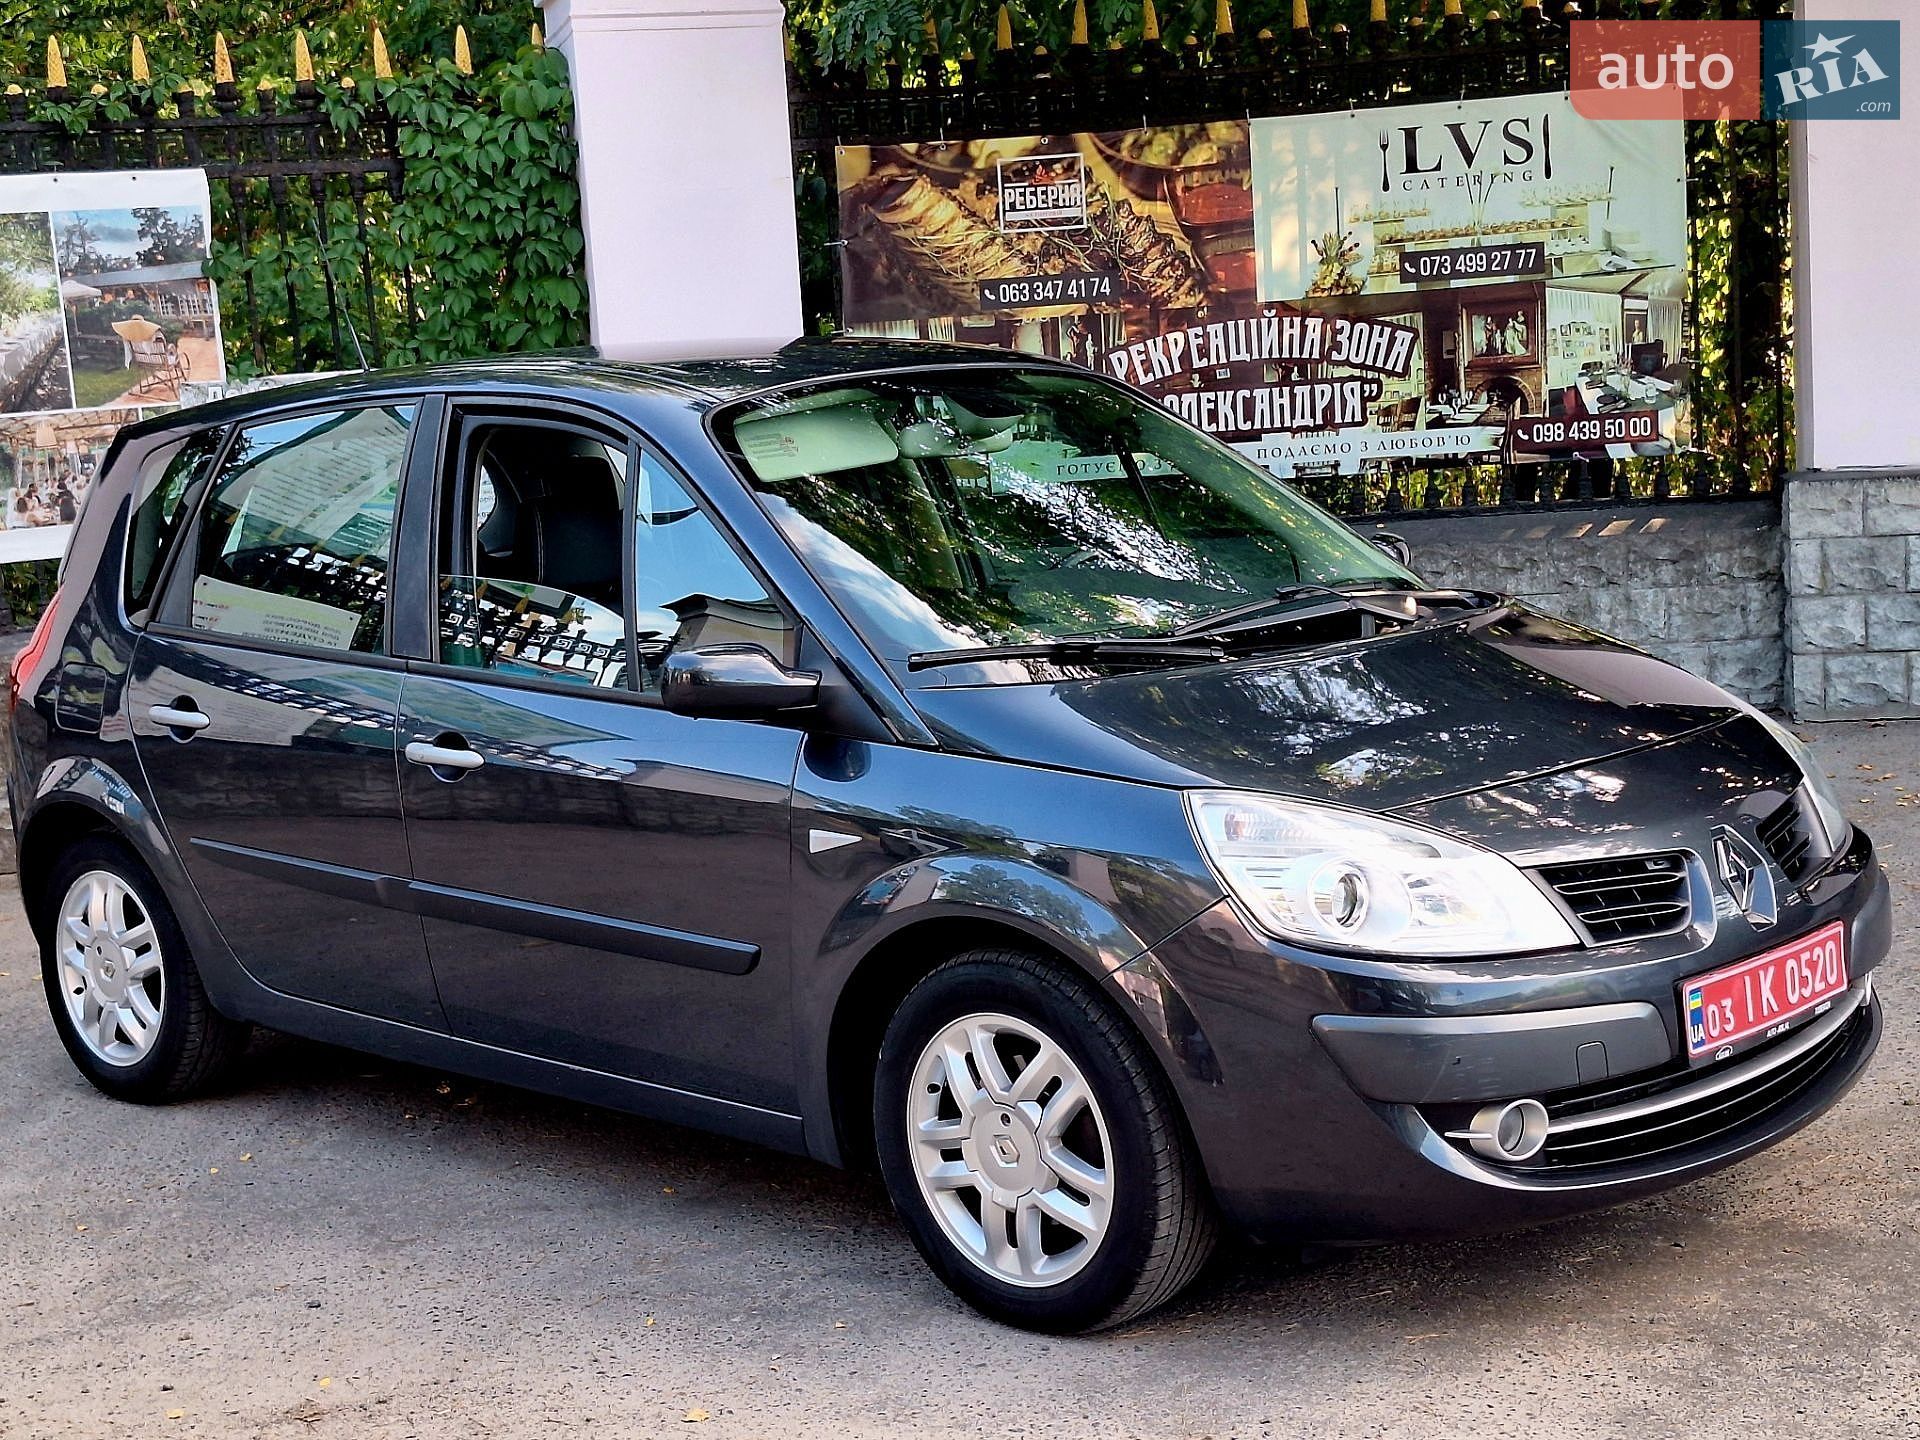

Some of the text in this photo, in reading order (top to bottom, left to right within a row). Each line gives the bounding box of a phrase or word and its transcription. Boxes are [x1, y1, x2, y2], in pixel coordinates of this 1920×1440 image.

[1397, 117, 1534, 175] LVS
[1402, 170, 1533, 191] CATERING
[1004, 183, 1081, 211] РЕБЕРНЯ
[1419, 248, 1537, 276] 073 499 27 77
[999, 276, 1111, 303] 063 347 41 74
[1108, 308, 1415, 386] РЕКРЕАЦІЙНА ЗОНА
[1533, 416, 1651, 443] 098 439 50 00
[1257, 442, 1352, 459] ПОДАЄМО
[1056, 459, 1146, 476] ГОТУЄО
[1706, 940, 1838, 1038] 03 IK 0520
[1690, 1024, 1706, 1044] UA
